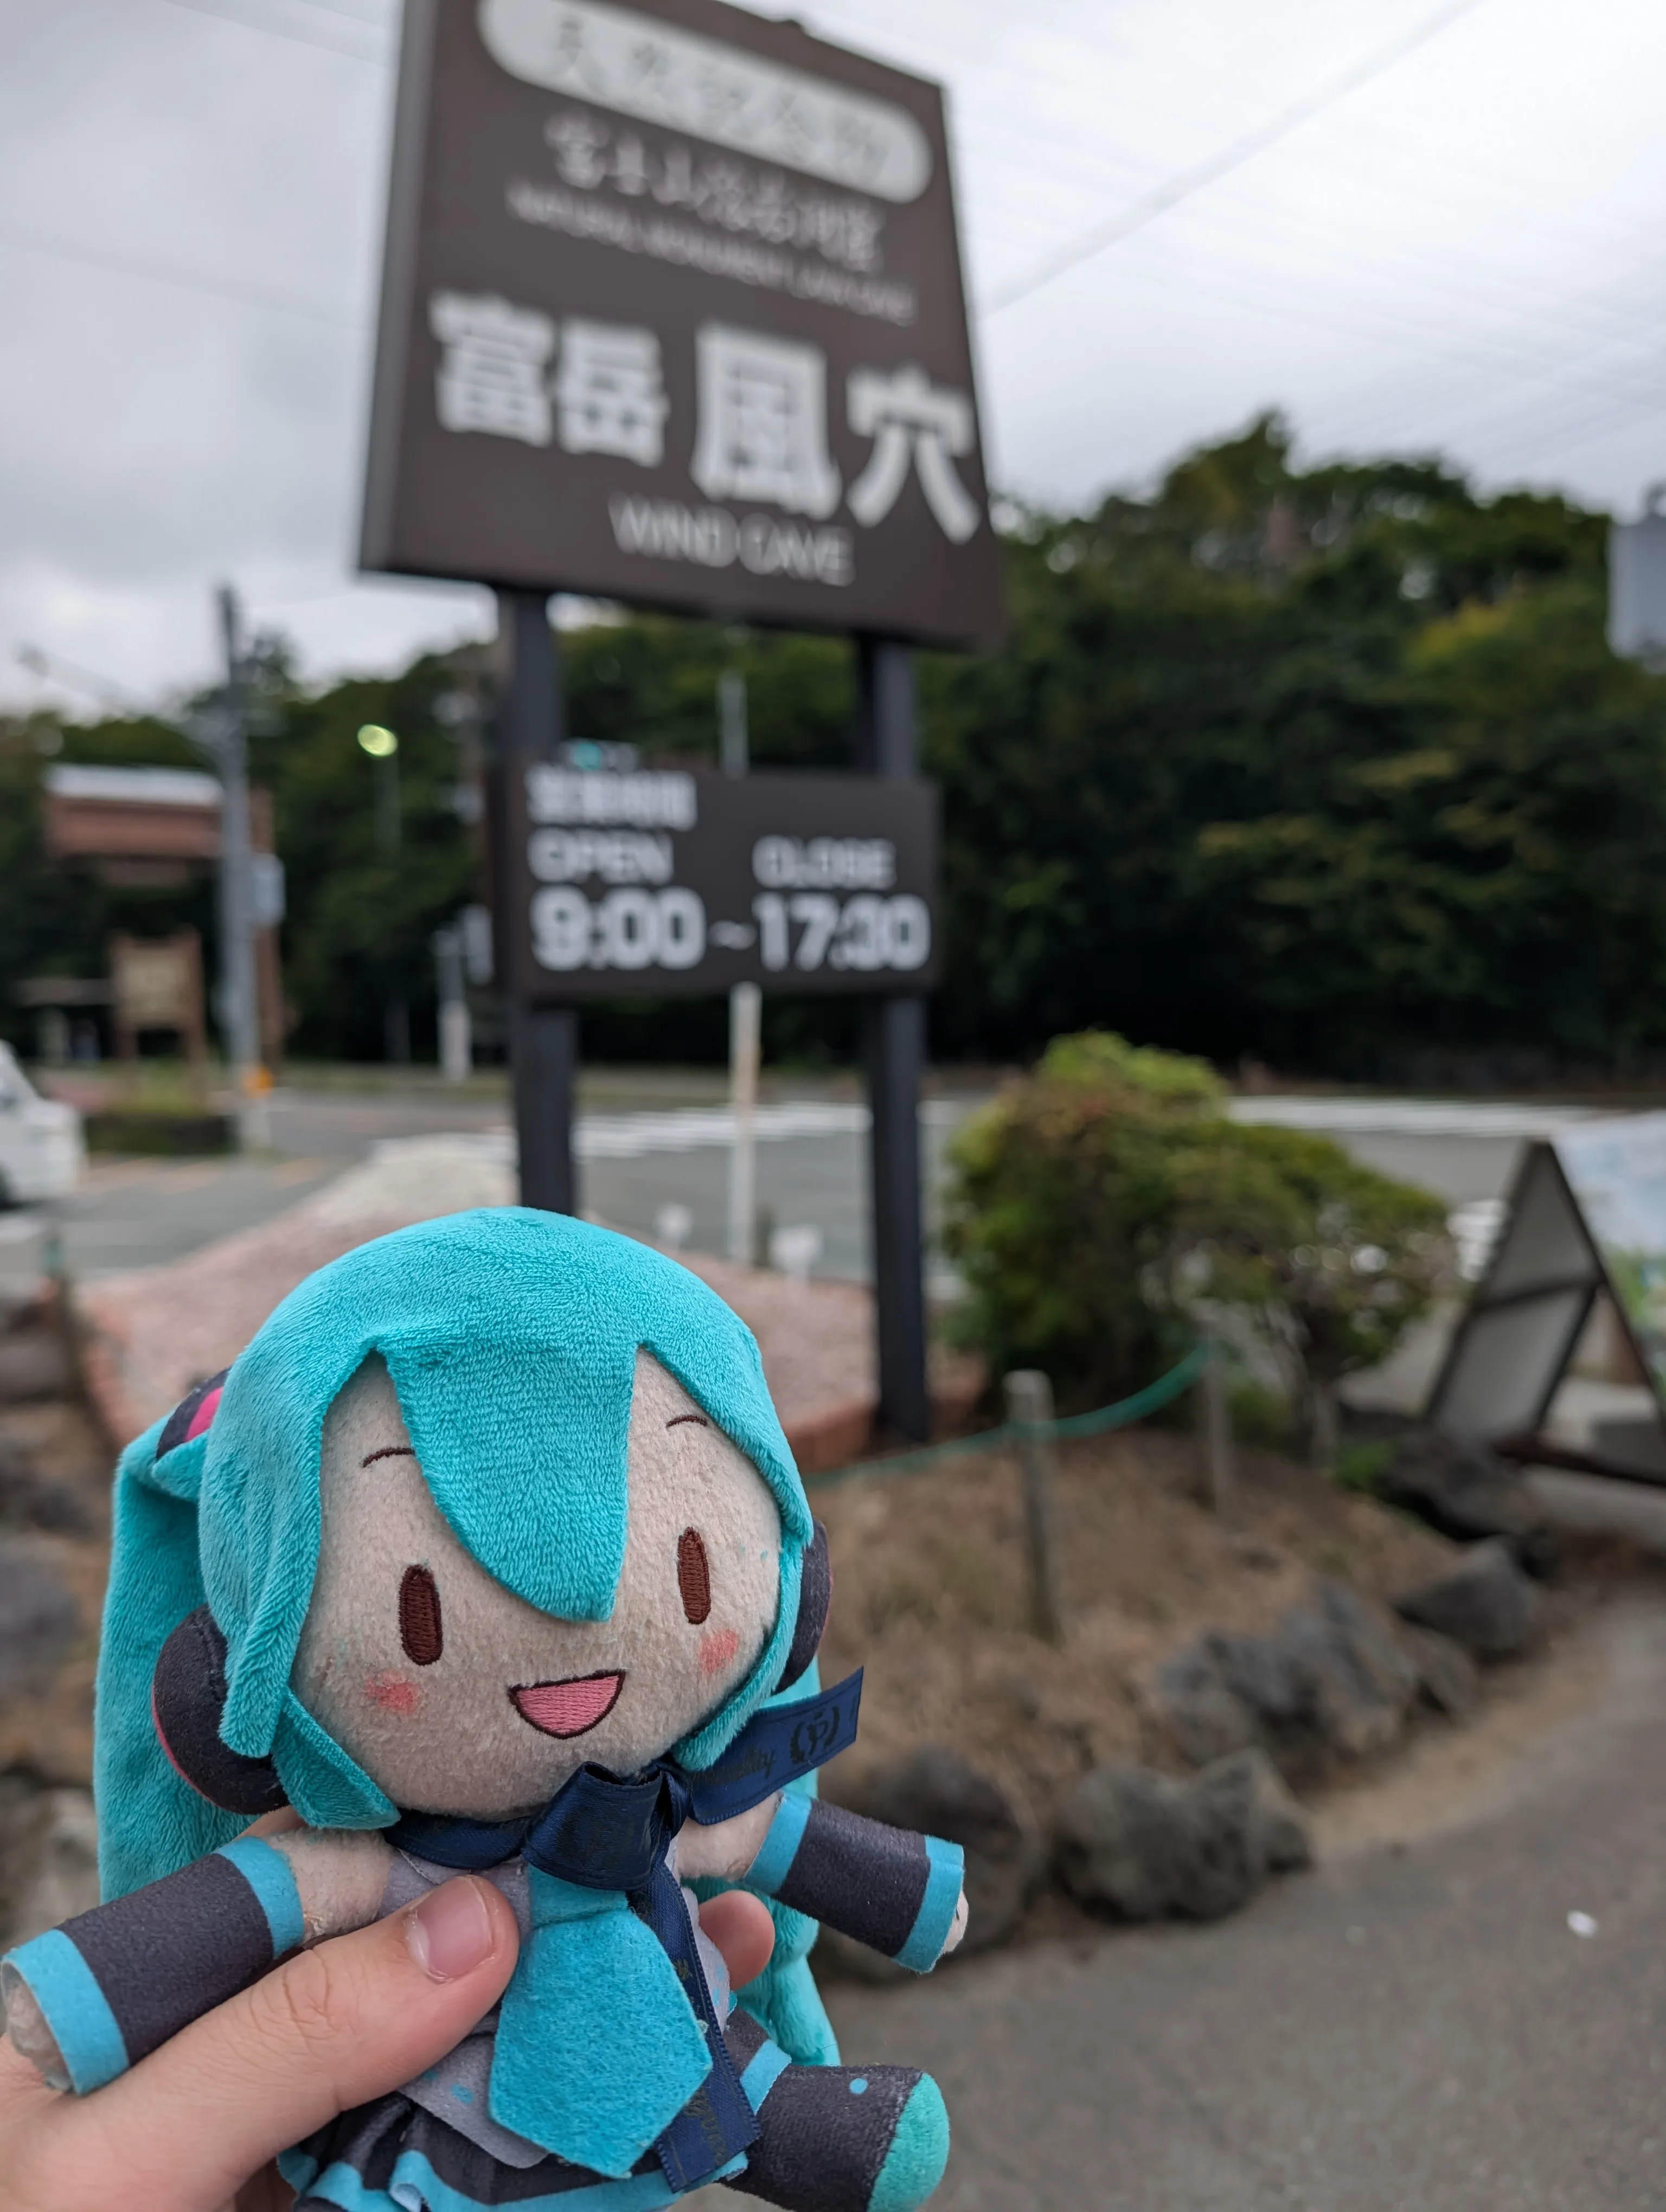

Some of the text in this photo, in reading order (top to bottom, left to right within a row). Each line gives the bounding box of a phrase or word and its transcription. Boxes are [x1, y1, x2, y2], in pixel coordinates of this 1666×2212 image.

[432, 292, 978, 542] 富岳風穴
[610, 492, 855, 584] WIND CAVE
[528, 827, 896, 889] OPEN CLOSE
